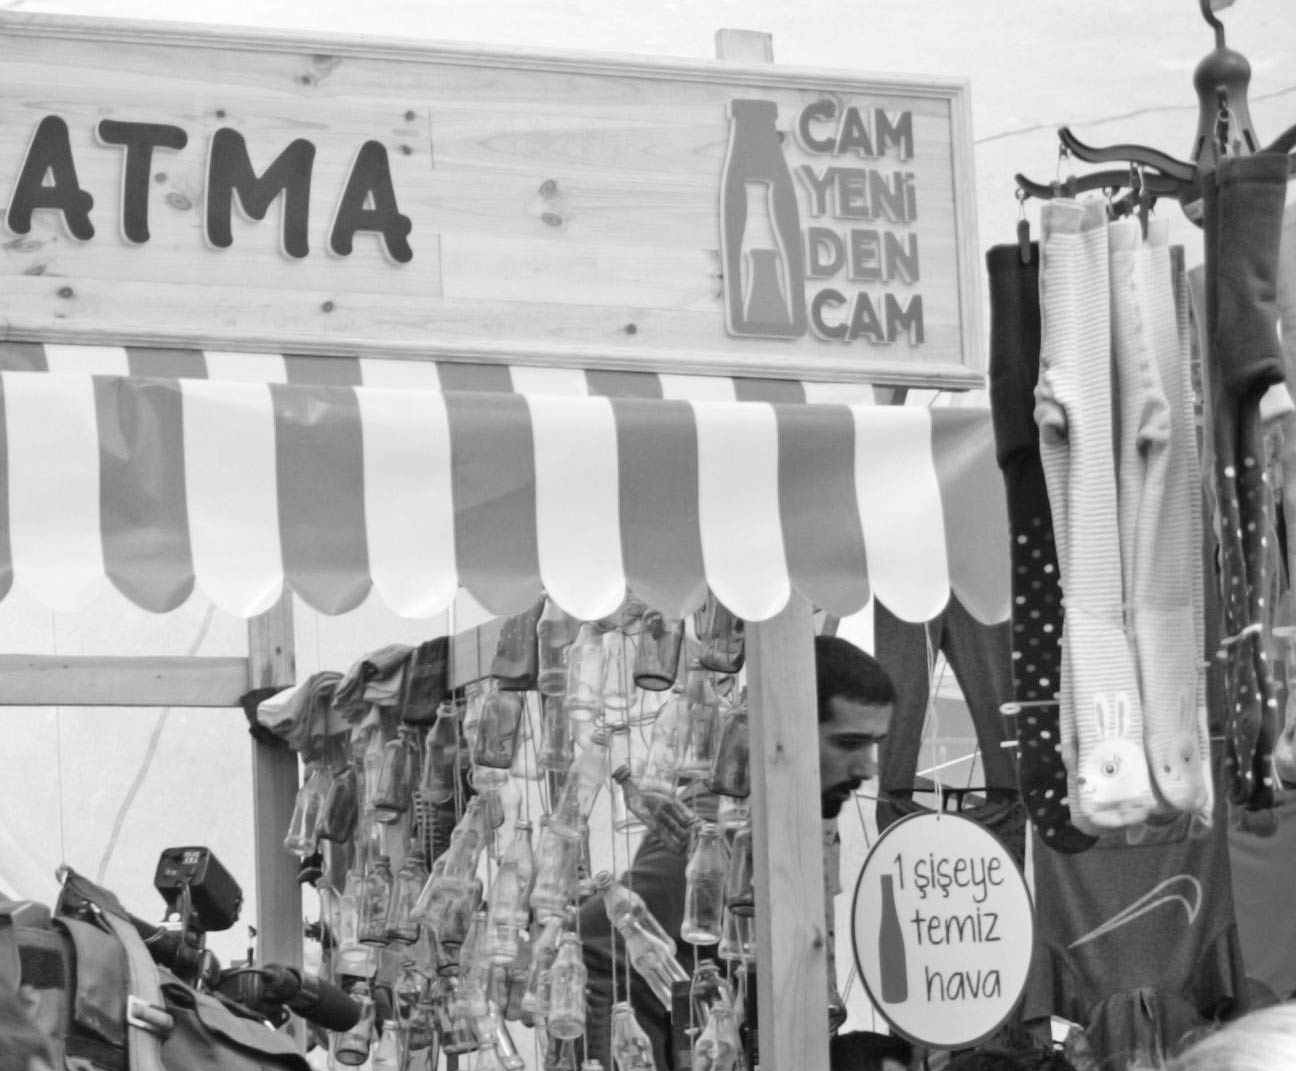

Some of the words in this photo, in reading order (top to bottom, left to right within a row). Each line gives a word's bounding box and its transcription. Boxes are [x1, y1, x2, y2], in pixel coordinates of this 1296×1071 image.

[796, 98, 915, 160] CAM
[8, 114, 415, 264] ATMA
[802, 226, 921, 284] DEN
[810, 287, 926, 346] CAM
[893, 853, 905, 889] 1
[913, 853, 1005, 903] şişeye
[910, 907, 1002, 946] temiz
[924, 965, 1002, 1003] hava
